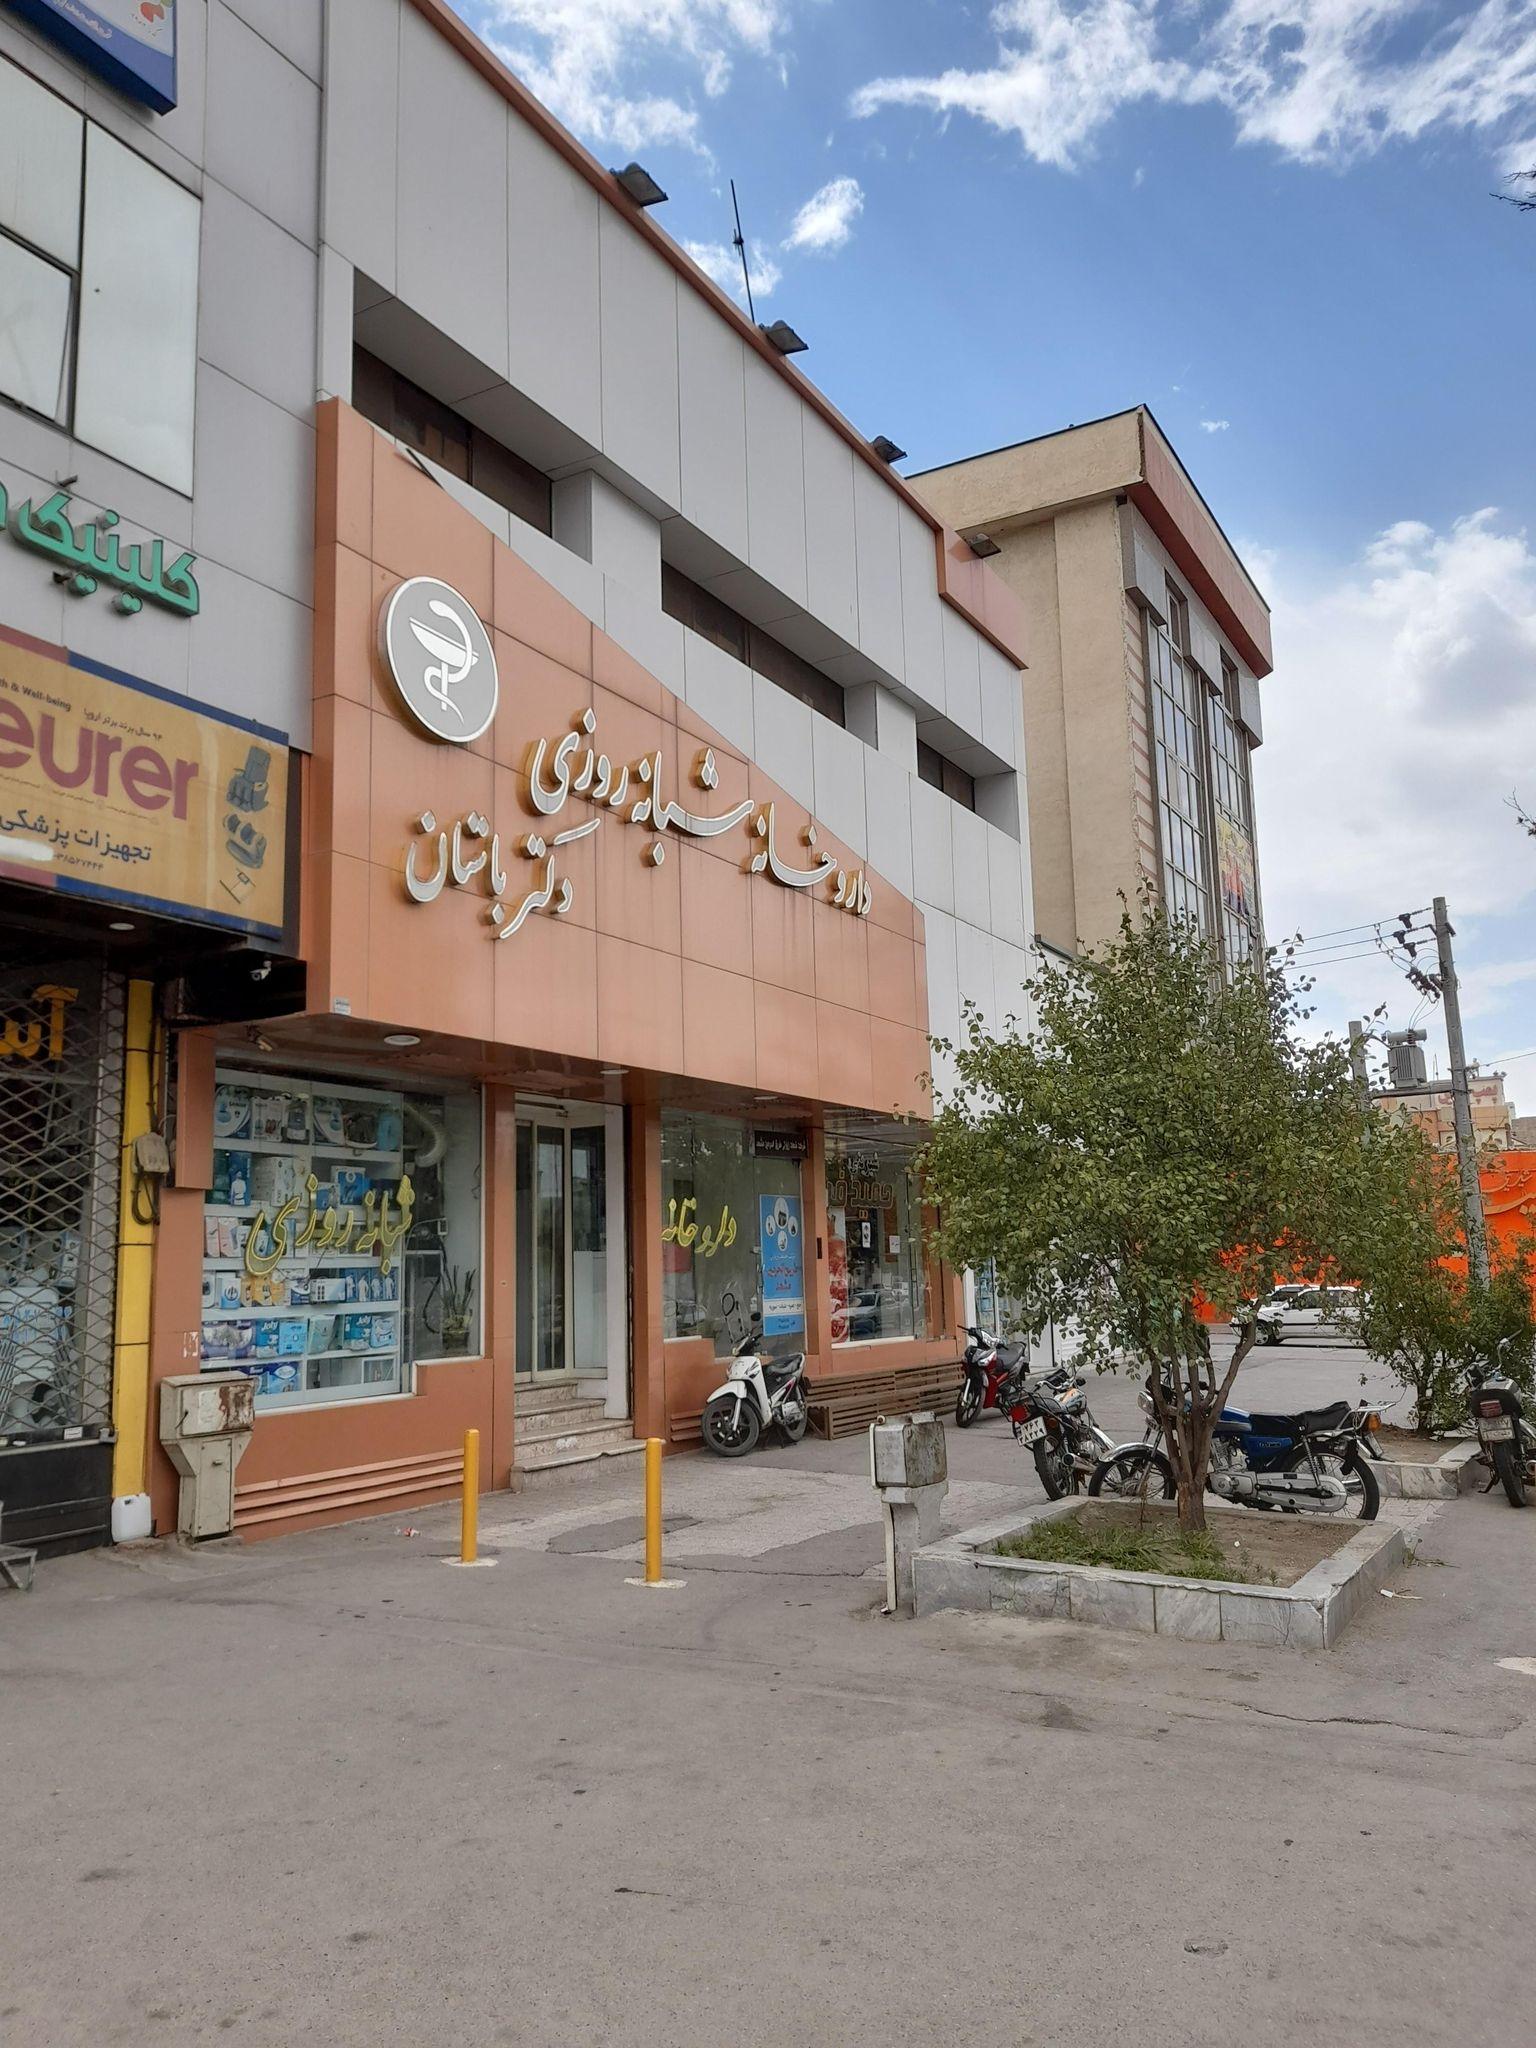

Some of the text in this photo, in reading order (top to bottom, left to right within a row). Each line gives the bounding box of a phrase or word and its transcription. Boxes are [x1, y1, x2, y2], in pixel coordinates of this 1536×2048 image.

[18, 490, 199, 616] کلینیک
[22, 685, 72, 712] Well-being
[0, 809, 152, 864] تجهیزات پزشکی
[404, 810, 601, 940] دکتر باستان
[661, 1197, 737, 1258] داروخانه
